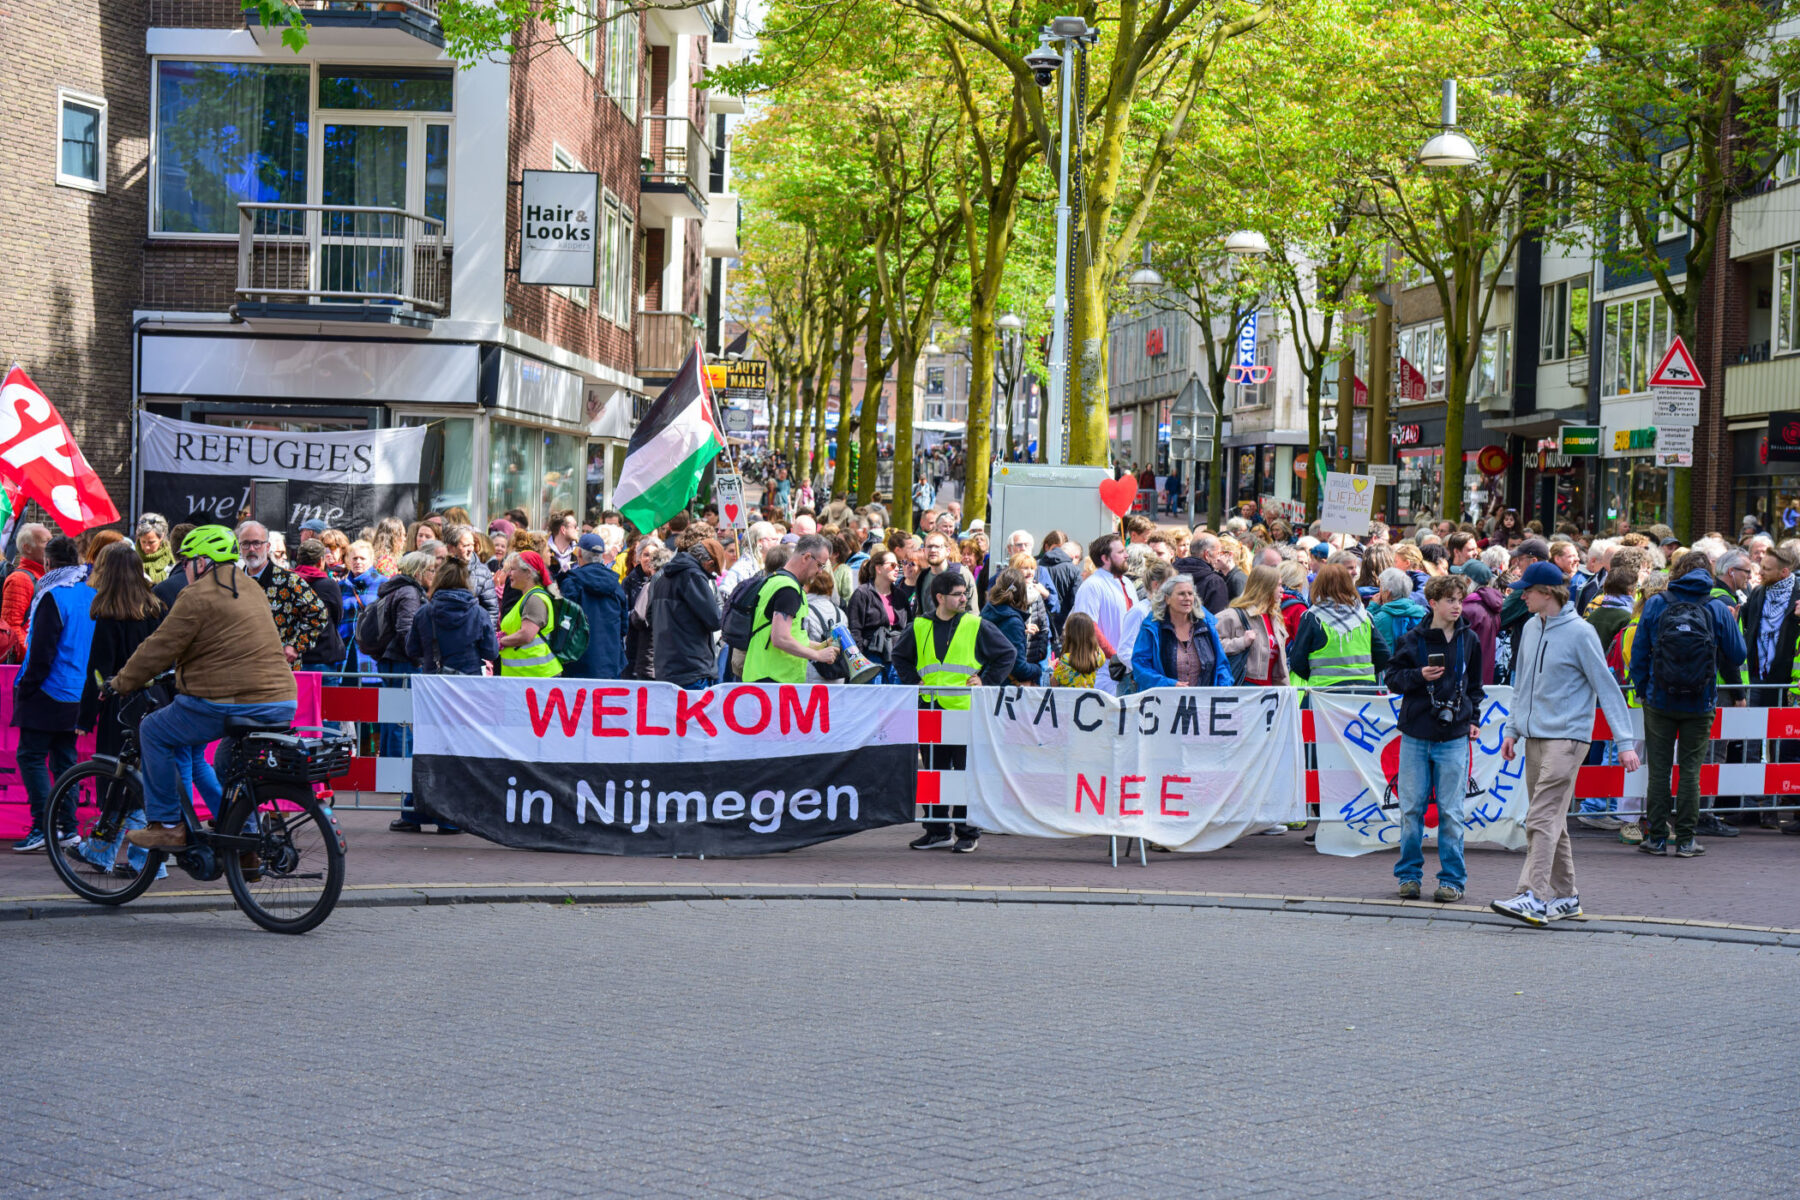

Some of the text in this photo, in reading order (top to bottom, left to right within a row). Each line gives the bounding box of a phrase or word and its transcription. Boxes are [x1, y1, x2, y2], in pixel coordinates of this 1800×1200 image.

[527, 204, 587, 223] Hair &
[526, 222, 590, 240] Looks
[720, 361, 766, 374] EAUTY
[730, 375, 765, 388] NAILS
[1564, 437, 1598, 445] SUBWAY
[174, 432, 373, 474] REFUGEES
[1522, 452, 1573, 468] TACO MUNDO
[1328, 489, 1369, 506] LIEFDE
[525, 685, 830, 738] WELKOM
[993, 687, 1240, 736] RACISME
[1075, 772, 1191, 816] NEE
[506, 777, 859, 834] in Nijmegen
